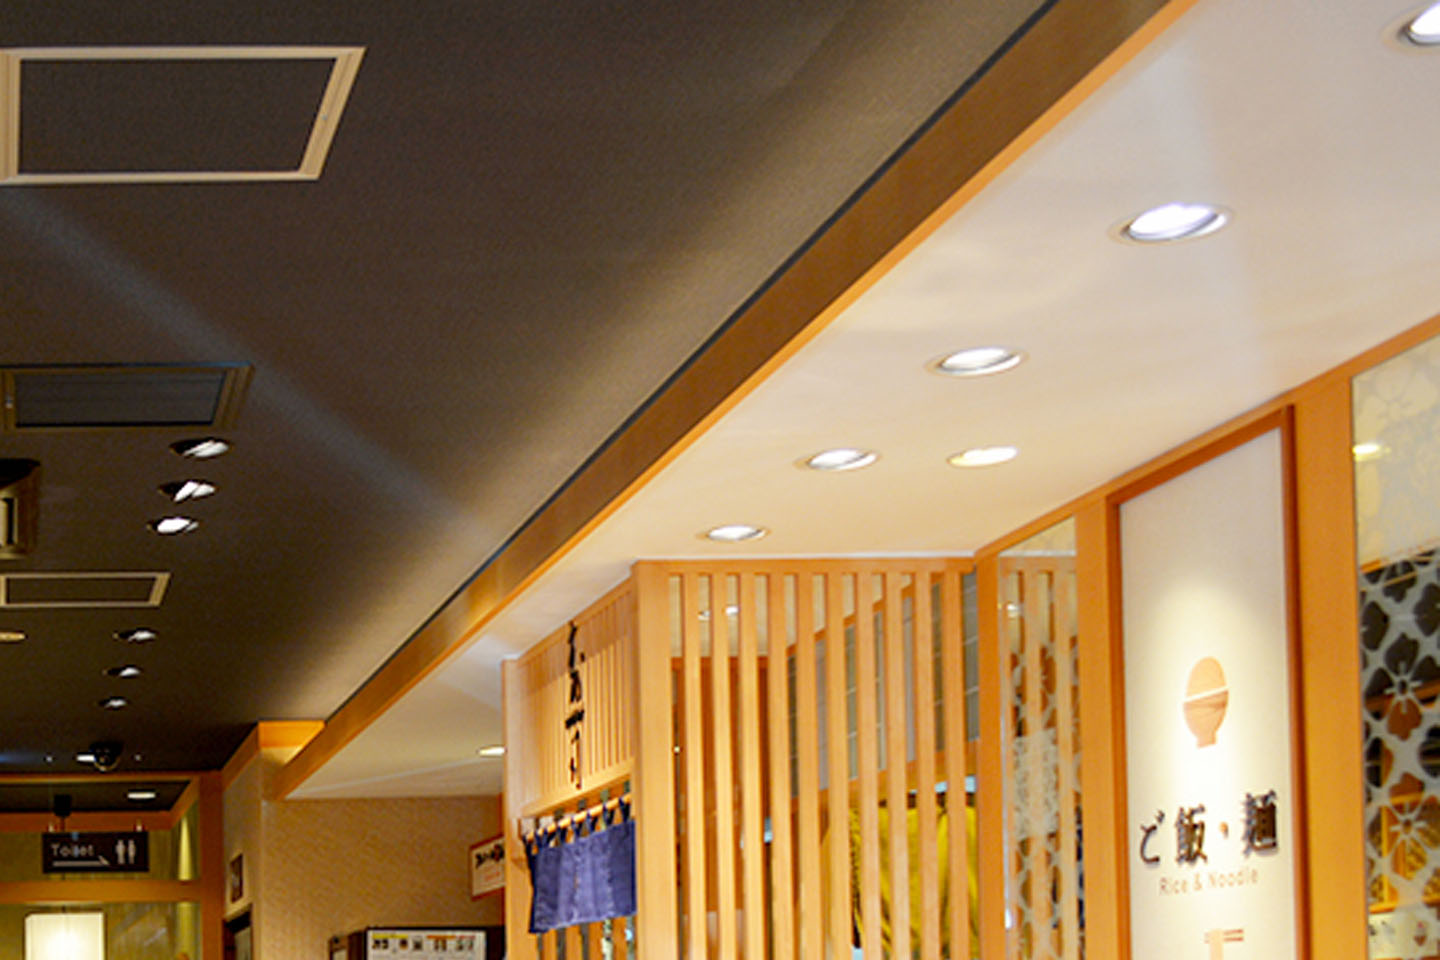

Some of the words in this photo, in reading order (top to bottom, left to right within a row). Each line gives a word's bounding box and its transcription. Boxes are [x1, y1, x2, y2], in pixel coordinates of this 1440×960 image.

[1139, 789, 1278, 866] ご飯・麺
[1159, 876, 1188, 896] Rice
[1193, 873, 1203, 891] &
[1207, 866, 1259, 889] Noodle
